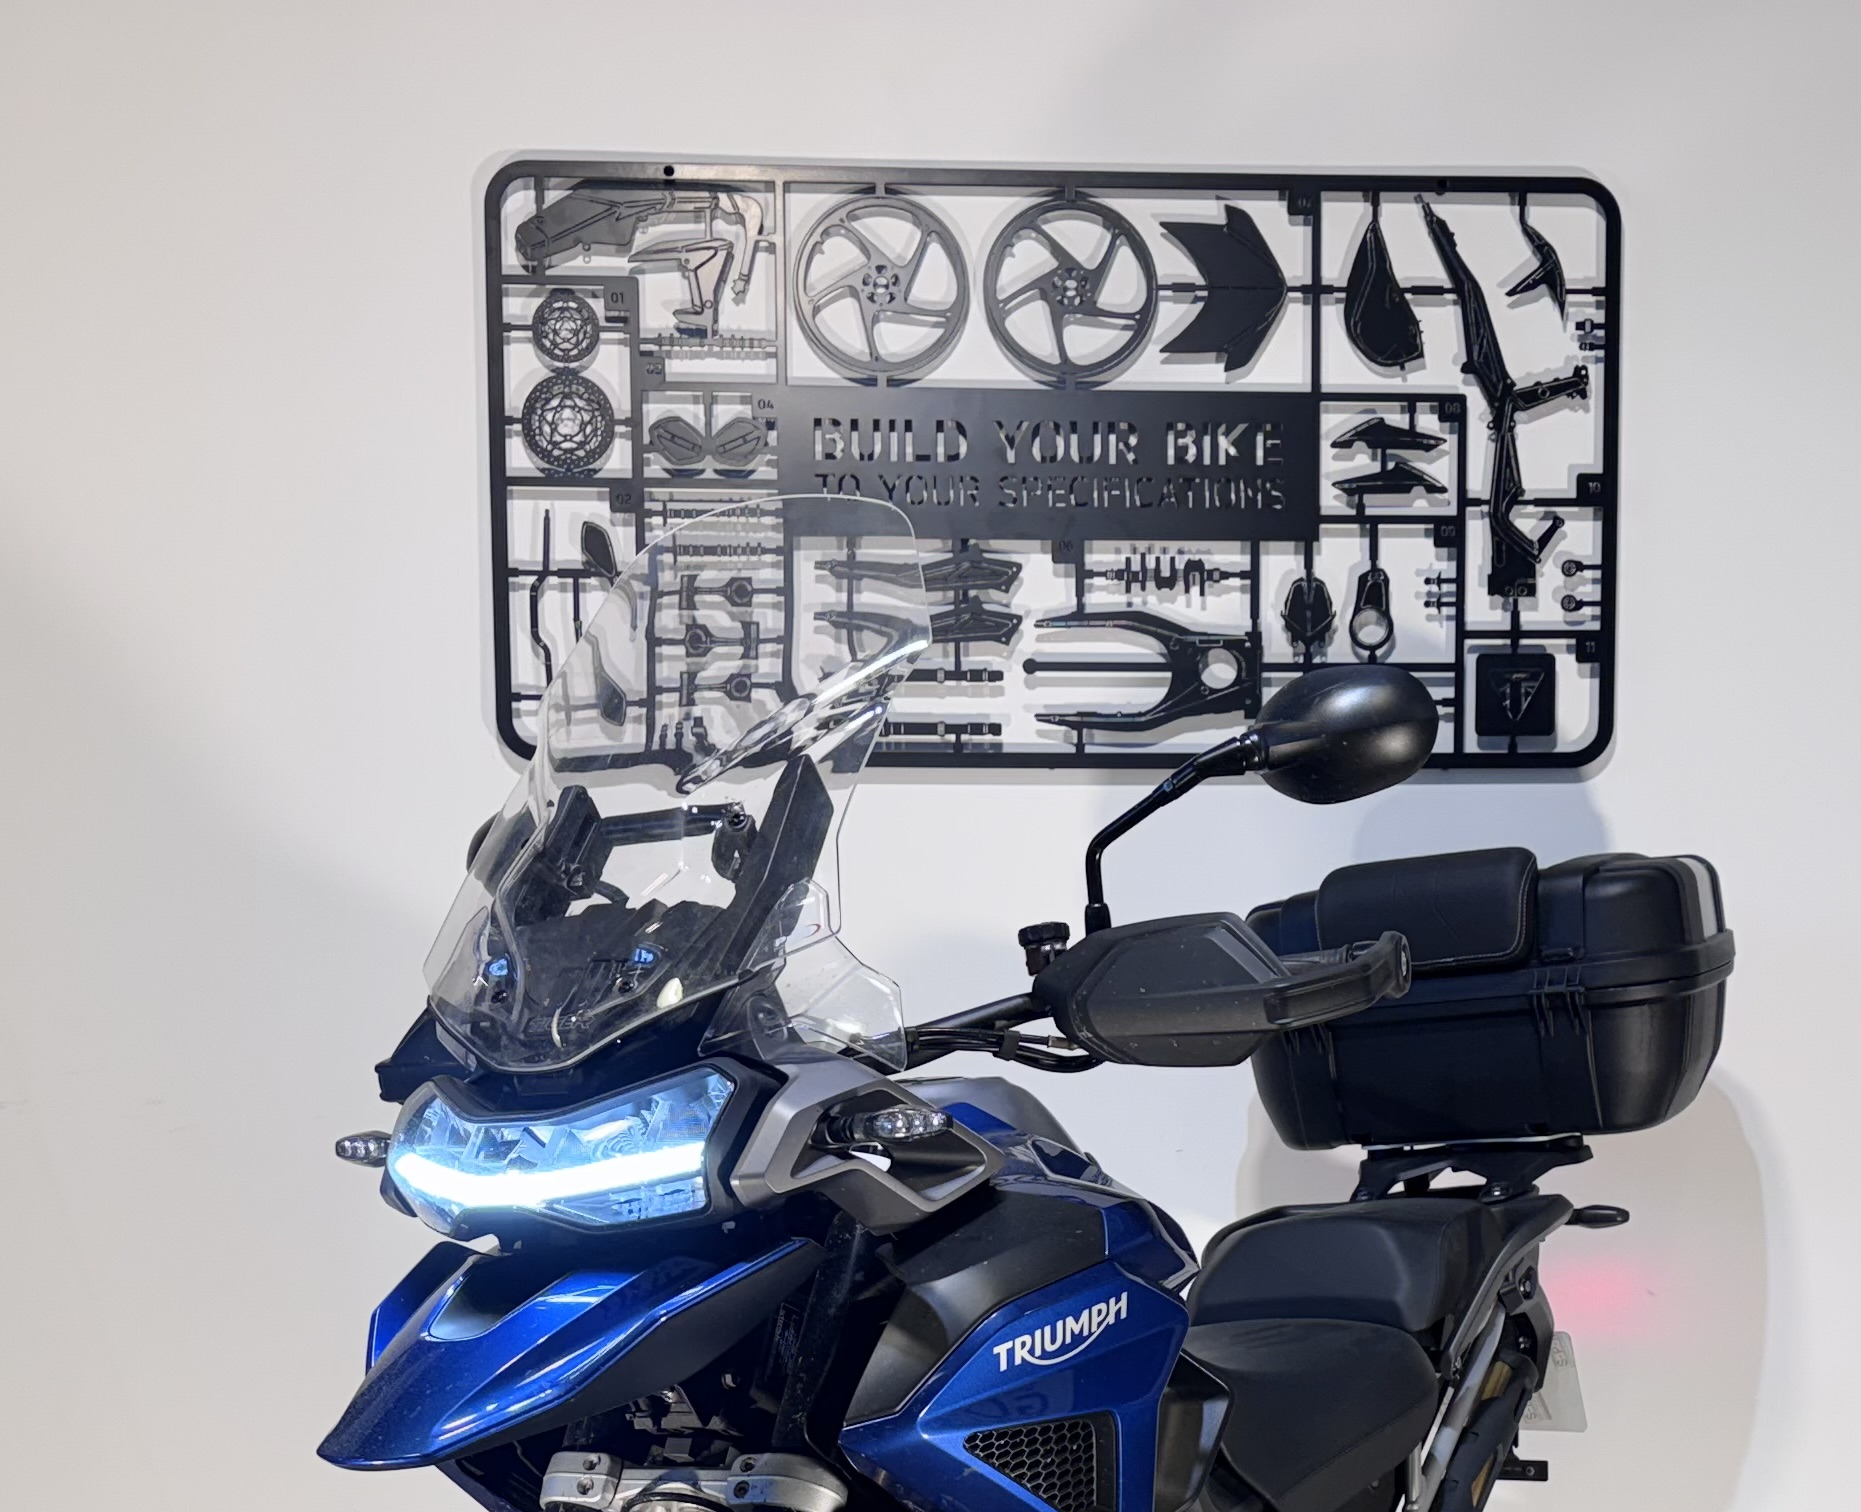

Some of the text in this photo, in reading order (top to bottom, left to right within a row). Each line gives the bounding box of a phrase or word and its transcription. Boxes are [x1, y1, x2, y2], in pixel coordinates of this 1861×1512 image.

[610, 292, 625, 305] 01
[757, 398, 775, 410] 04
[814, 417, 1283, 465] BUILD YOUR BIKE
[815, 474, 1286, 509] TO YOUR SPECIFICATIONS
[1588, 481, 1601, 494] 10
[615, 492, 633, 506] 02
[1585, 640, 1596, 653] 11
[993, 1291, 1128, 1373] TRIUMPH
